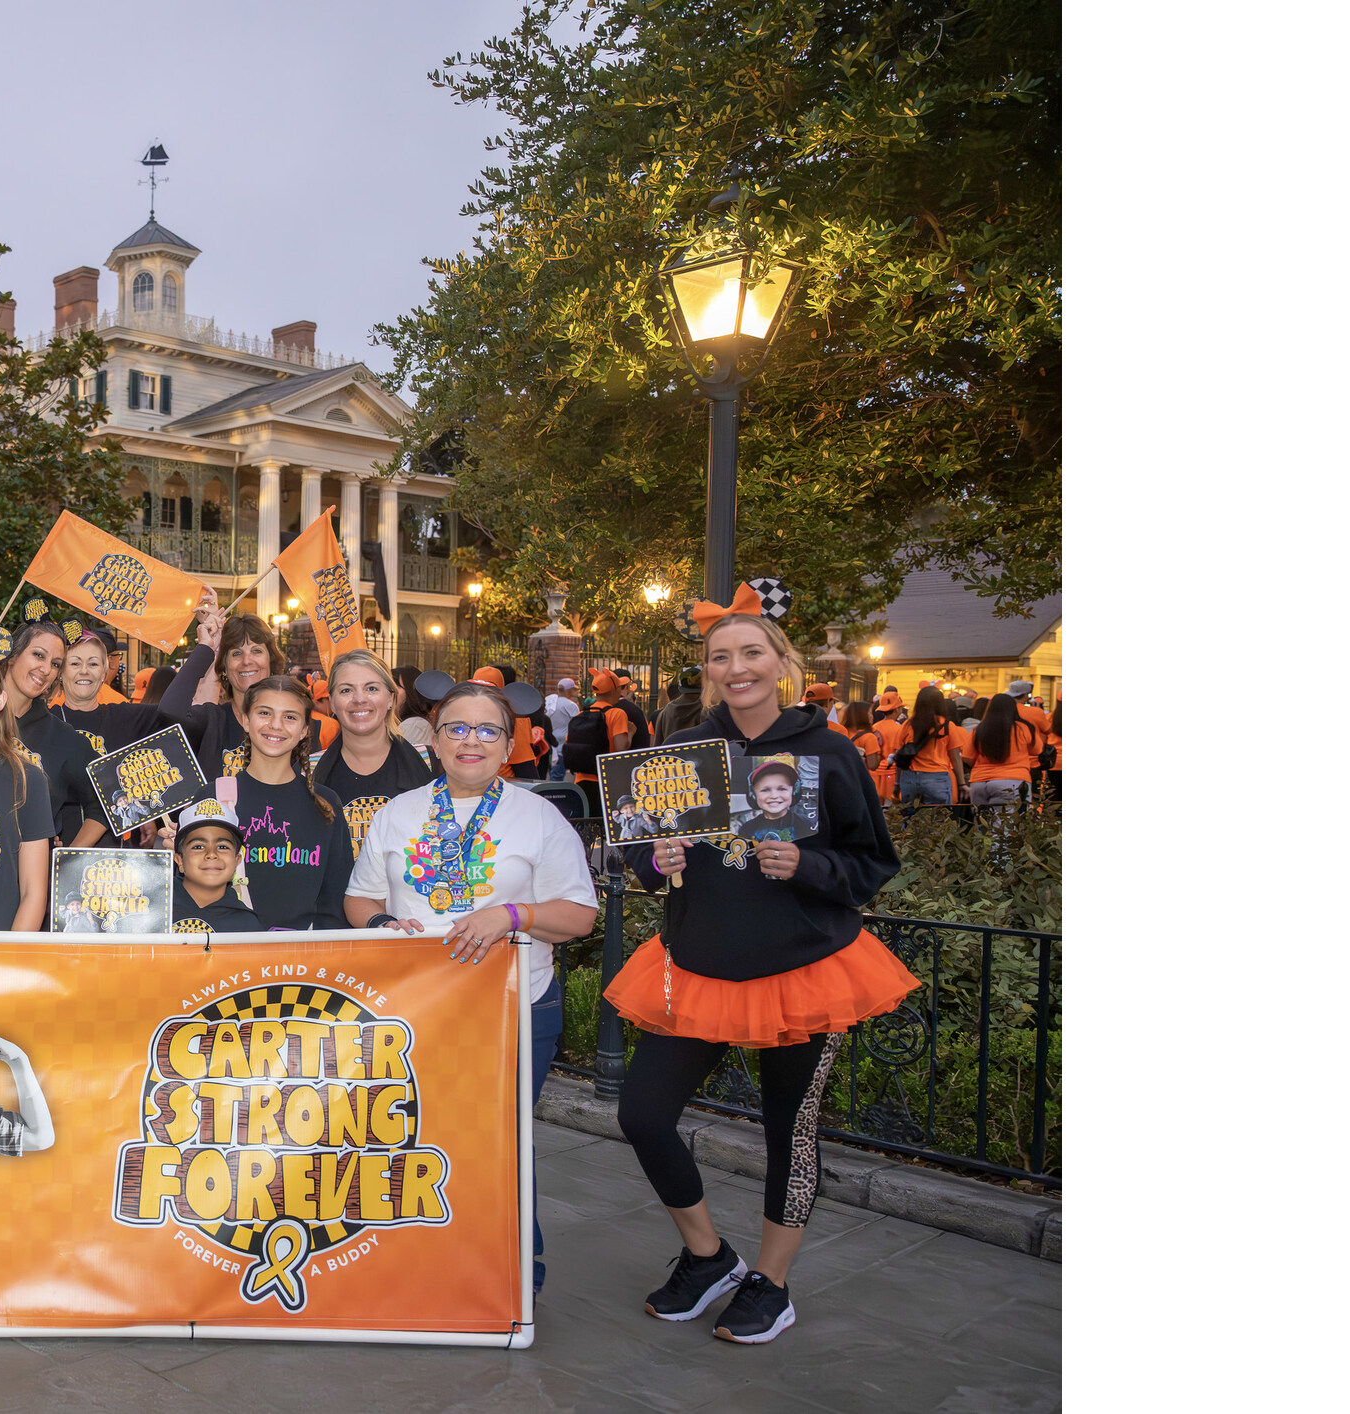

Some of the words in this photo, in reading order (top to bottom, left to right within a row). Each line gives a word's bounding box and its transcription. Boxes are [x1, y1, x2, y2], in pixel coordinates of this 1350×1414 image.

[95, 566, 146, 599] STRONG
[103, 556, 151, 588] CARTER
[82, 574, 146, 614] FOREVER
[325, 572, 356, 627] STRONG
[118, 750, 164, 778] CARTER
[122, 760, 170, 788] STRONG
[635, 763, 694, 782] CARTER
[125, 768, 182, 803] FOREVER
[636, 776, 697, 796] STRONG
[634, 790, 710, 814] FOREVER
[85, 882, 142, 896] STRONG
[86, 868, 140, 882] CARTER
[81, 896, 148, 912] FOREVER
[182, 970, 250, 1010] ALWAYS
[261, 964, 308, 978] KIND
[316, 967, 327, 978] &
[334, 971, 387, 1008] BRAVE
[158, 1020, 407, 1080] CARTER
[151, 1082, 407, 1147] STRONG
[121, 1146, 446, 1221] FOREVER
[174, 1230, 241, 1275] FOREVER
[310, 1264, 322, 1277] A
[326, 1234, 380, 1272] BUDDY
